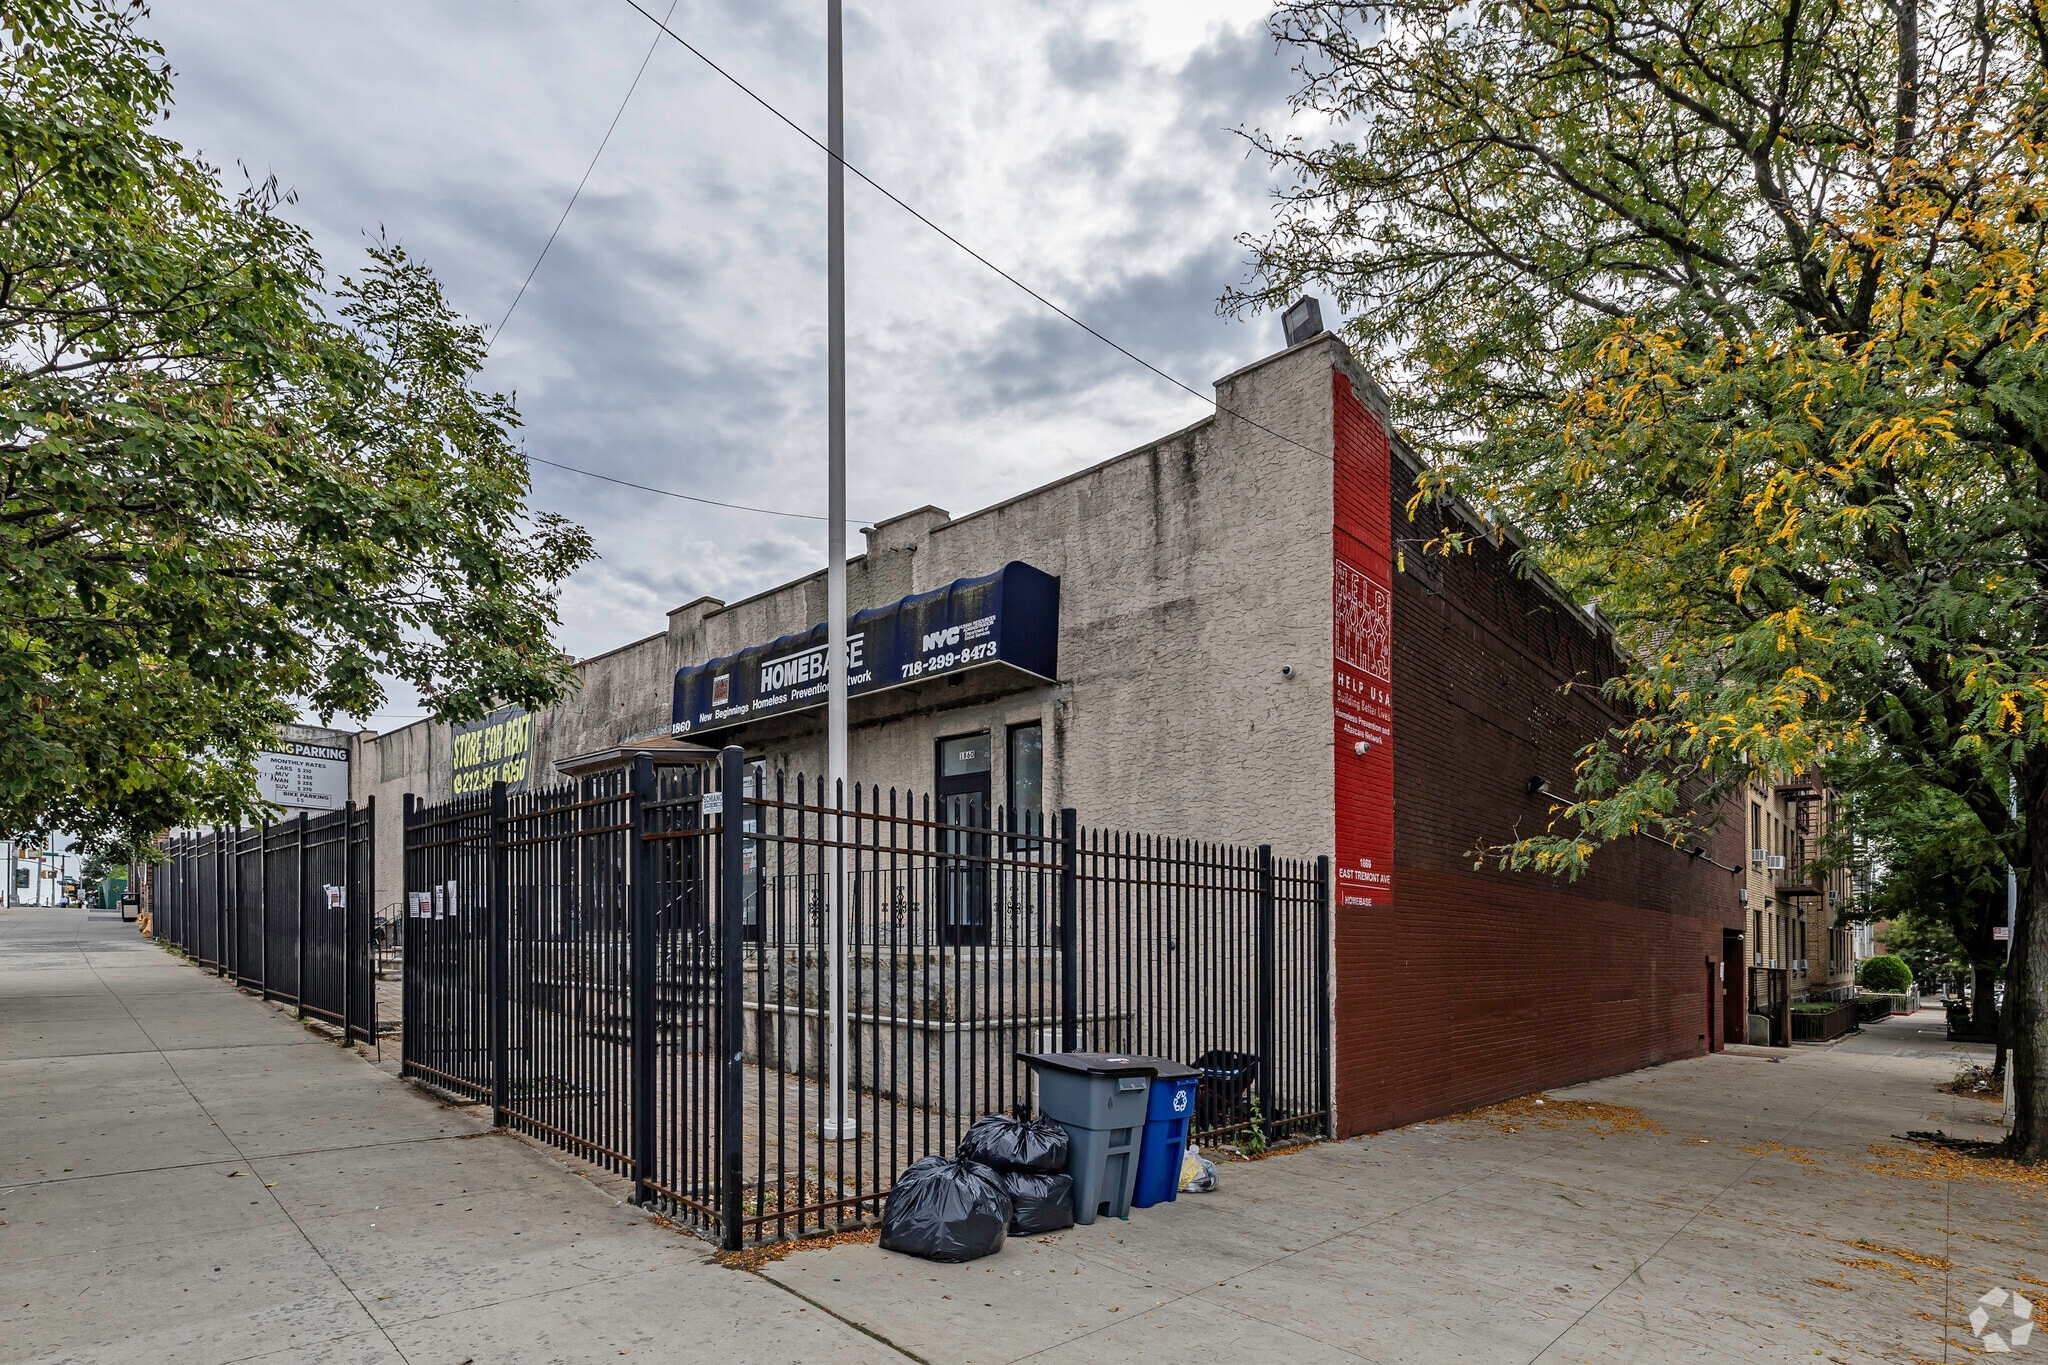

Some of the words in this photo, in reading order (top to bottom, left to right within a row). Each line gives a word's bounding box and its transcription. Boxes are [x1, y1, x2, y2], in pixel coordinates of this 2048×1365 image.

[923, 626, 960, 652] NYC
[761, 640, 864, 693] HOMEBAE
[902, 641, 996, 678] 718-299-8473
[699, 713, 712, 722] New
[715, 704, 749, 719] Beginnings
[752, 693, 788, 710] Homeless
[847, 670, 872, 686] twork
[1338, 672, 1364, 694] HELP
[1370, 687, 1390, 706] USA
[1337, 690, 1360, 711] Building
[1361, 700, 1377, 716] Better
[1378, 707, 1390, 721] Lives
[672, 720, 690, 734] 1860
[1335, 707, 1357, 723] Homeless
[1358, 716, 1381, 732] Prevention
[1382, 727, 1390, 736] and
[296, 744, 346, 760] PARKING
[454, 730, 482, 770] STORE
[484, 724, 503, 763] FOR
[504, 714, 531, 757] RENT
[271, 758, 303, 766] MONTHLY
[1339, 869, 1354, 878] EAST
[1355, 871, 1379, 882] TREMONT
[1380, 875, 1390, 884] AVE
[1345, 896, 1372, 906] HOMEBASE
